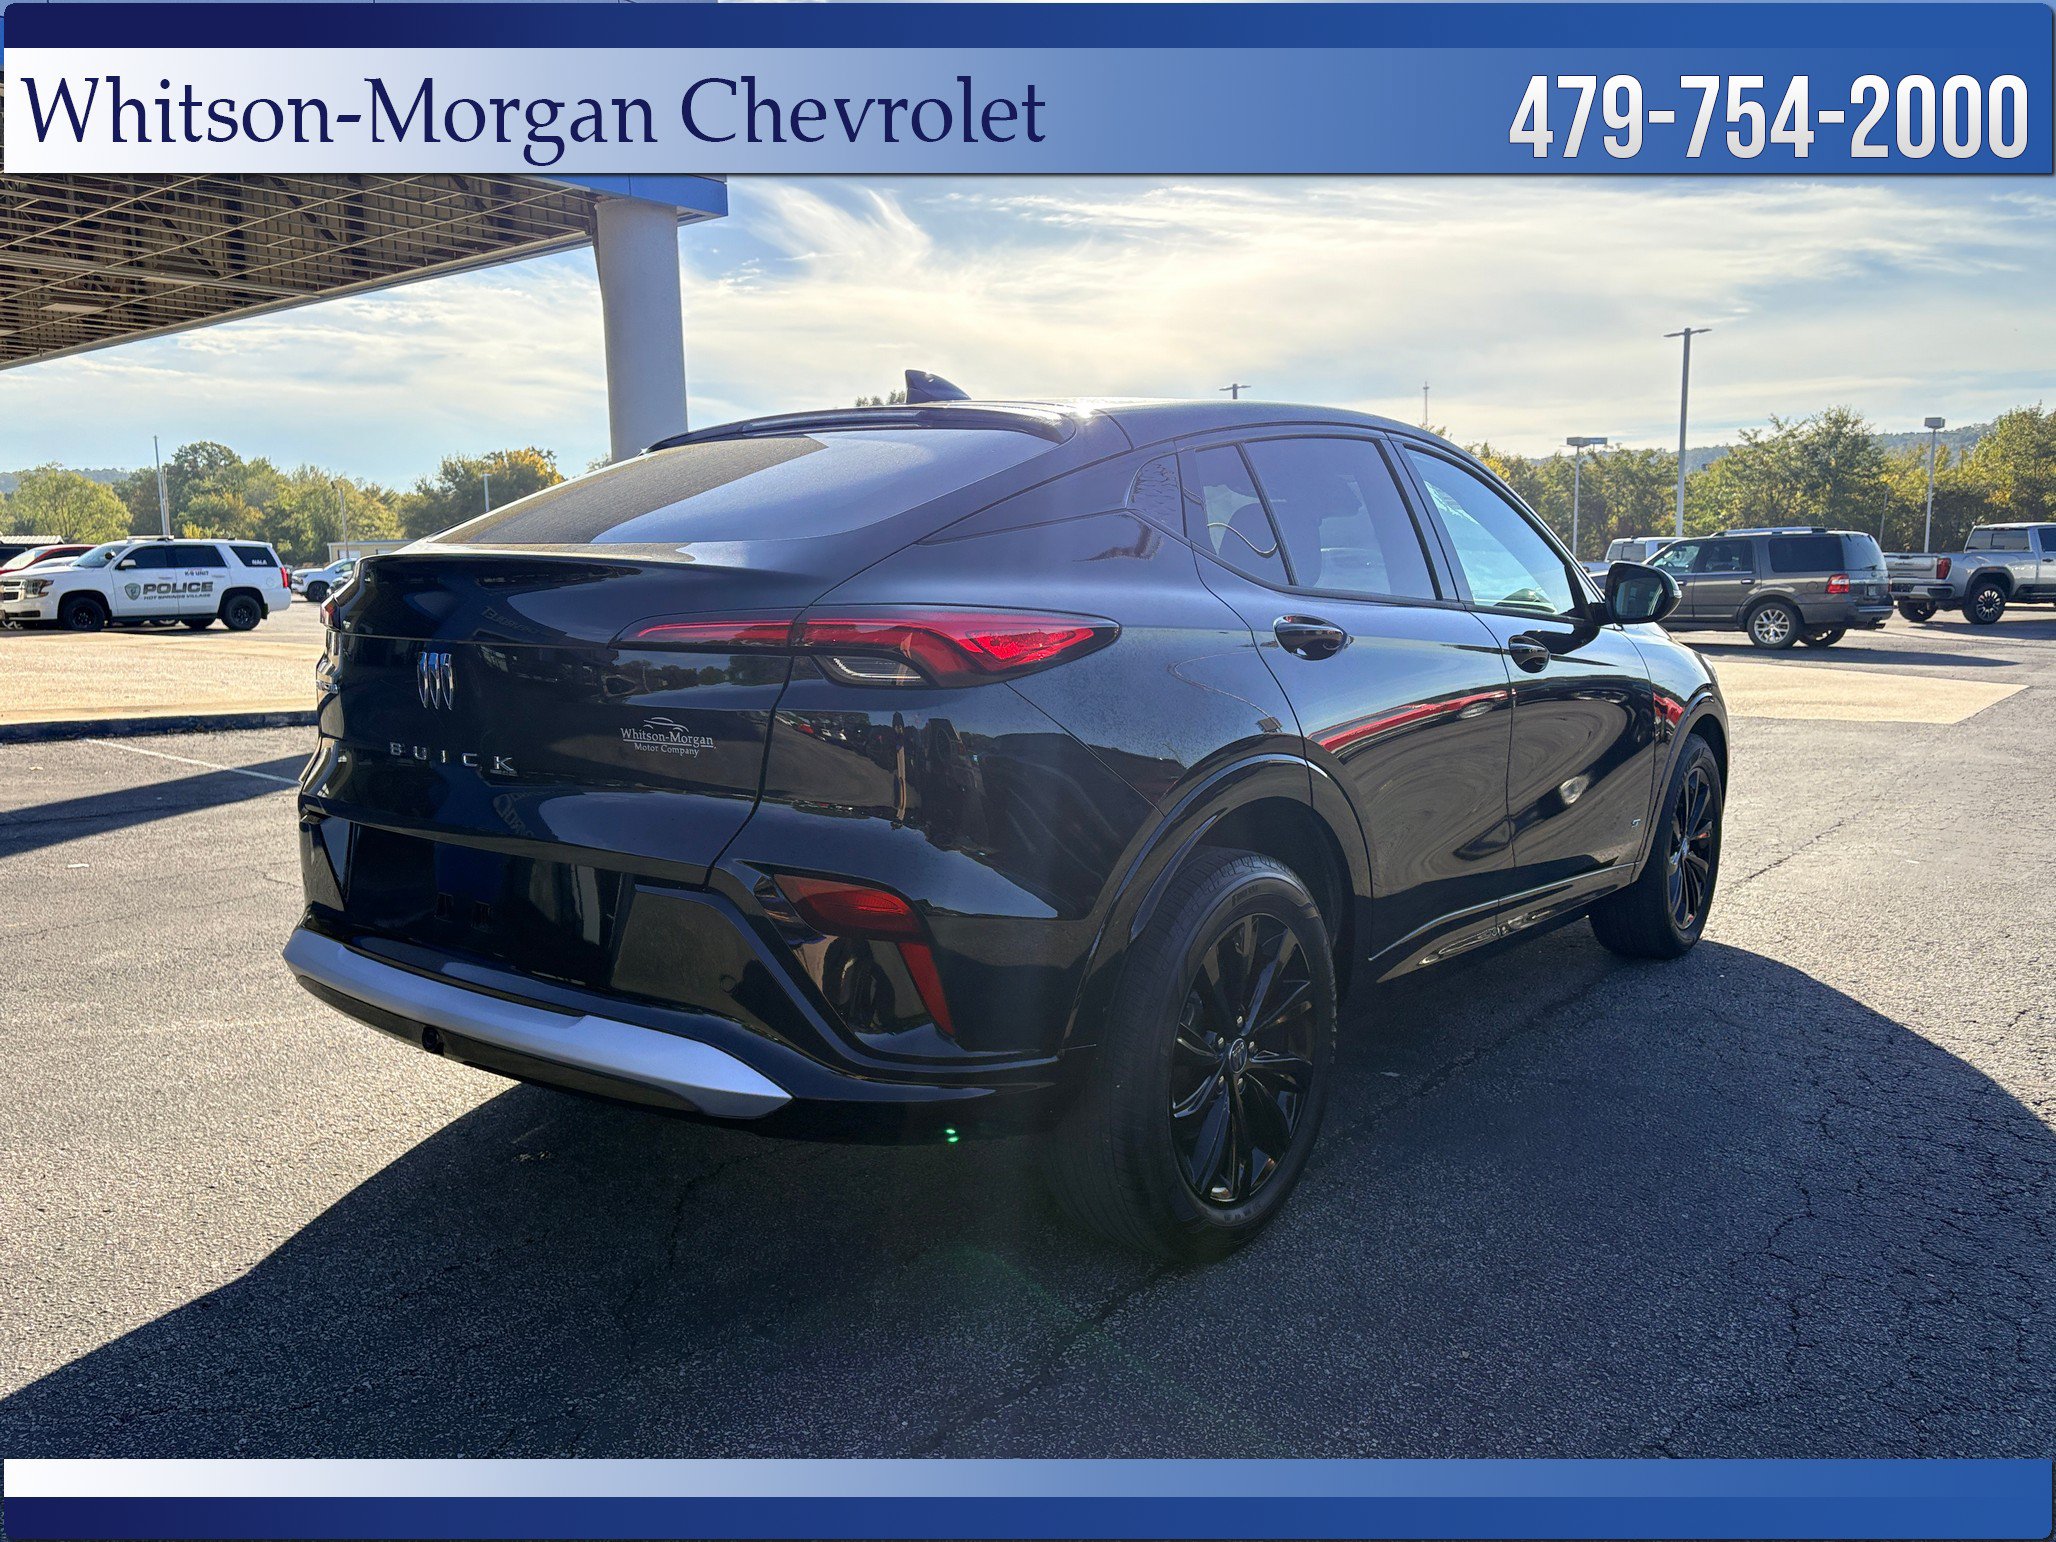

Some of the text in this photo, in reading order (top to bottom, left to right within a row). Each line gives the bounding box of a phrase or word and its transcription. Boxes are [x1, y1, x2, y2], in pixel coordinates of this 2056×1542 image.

[143, 582, 213, 595] POLICE
[620, 728, 713, 748] Whitson-Morgan
[389, 741, 515, 772] BUICK
[634, 743, 699, 758] Motor Company
